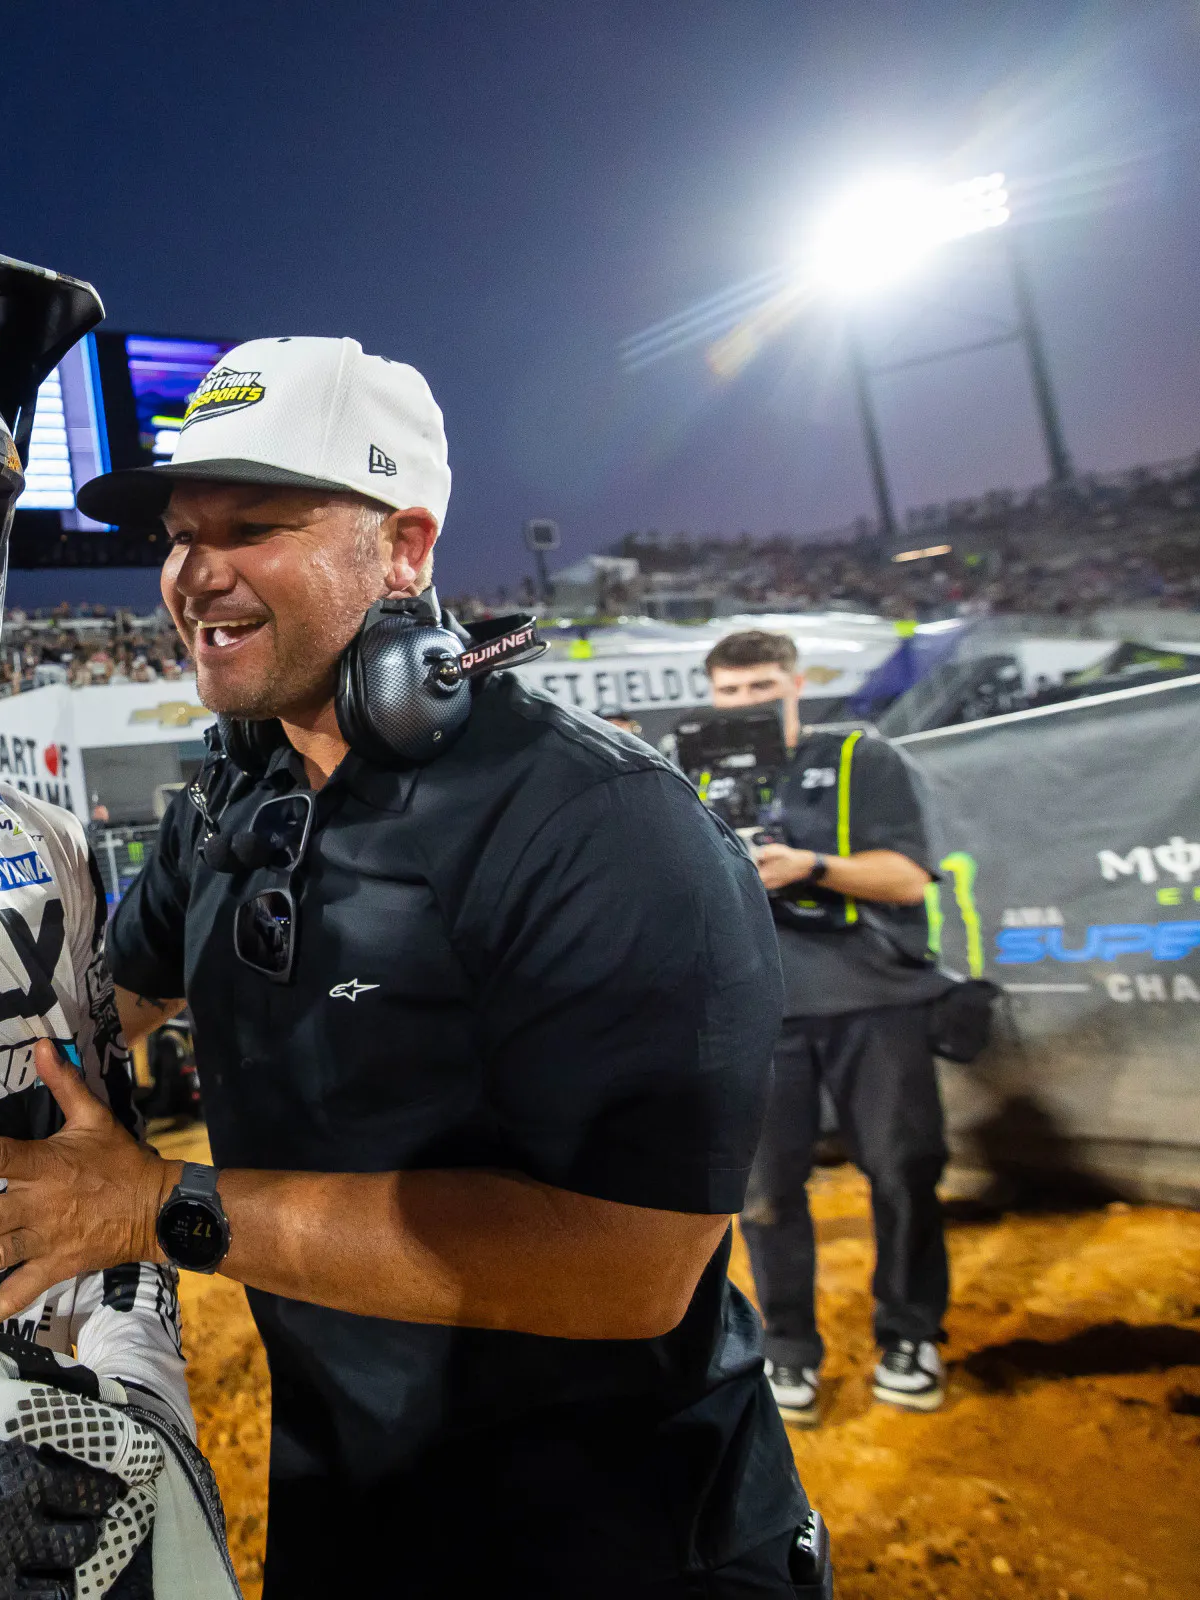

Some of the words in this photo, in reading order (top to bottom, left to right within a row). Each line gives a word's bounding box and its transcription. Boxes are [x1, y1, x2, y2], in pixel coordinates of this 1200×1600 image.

[197, 373, 259, 397] NTAIN
[595, 667, 684, 706] FIELD
[1097, 836, 1200, 883] MO
[995, 920, 1200, 964] SUPE
[1105, 973, 1200, 1003] CHA
